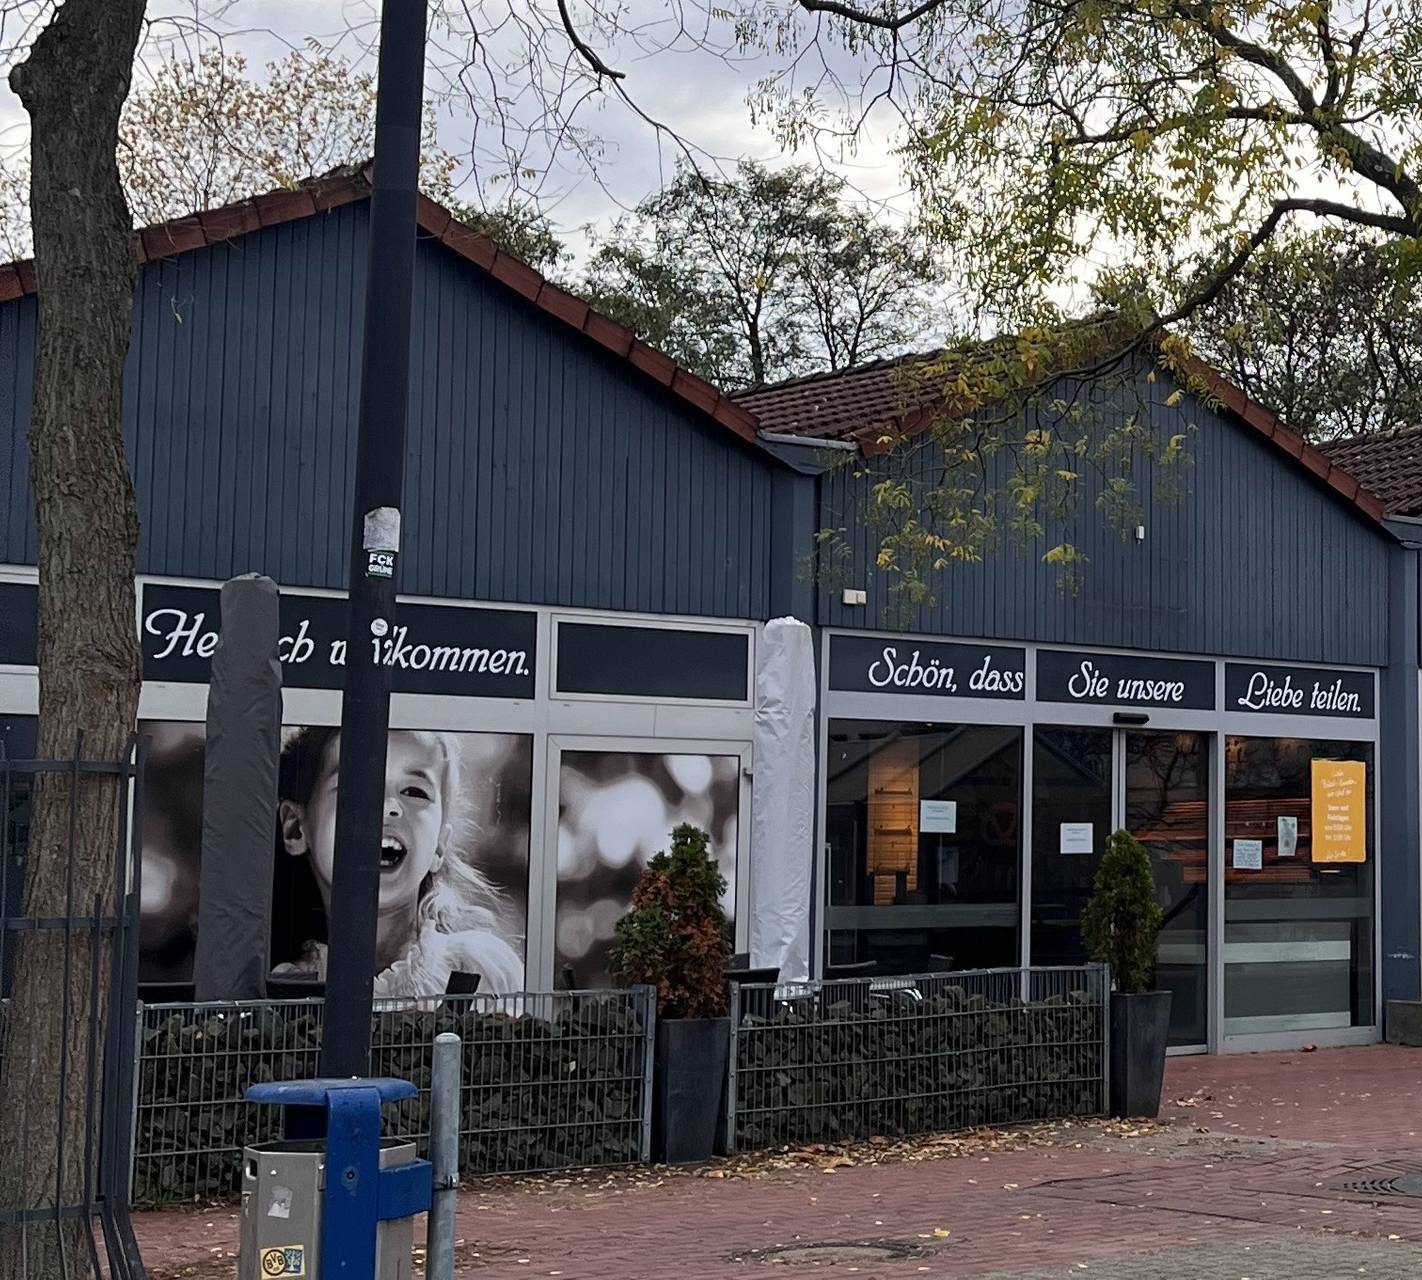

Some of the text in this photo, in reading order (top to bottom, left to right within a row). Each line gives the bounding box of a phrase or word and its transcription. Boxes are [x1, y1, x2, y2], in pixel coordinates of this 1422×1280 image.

[368, 552, 394, 567] FCK
[868, 647, 1024, 693] Schön, dass
[1067, 661, 1184, 702] Sie unsere
[1238, 671, 1362, 713] Liebe teilen.
[266, 1252, 284, 1270] BVB
